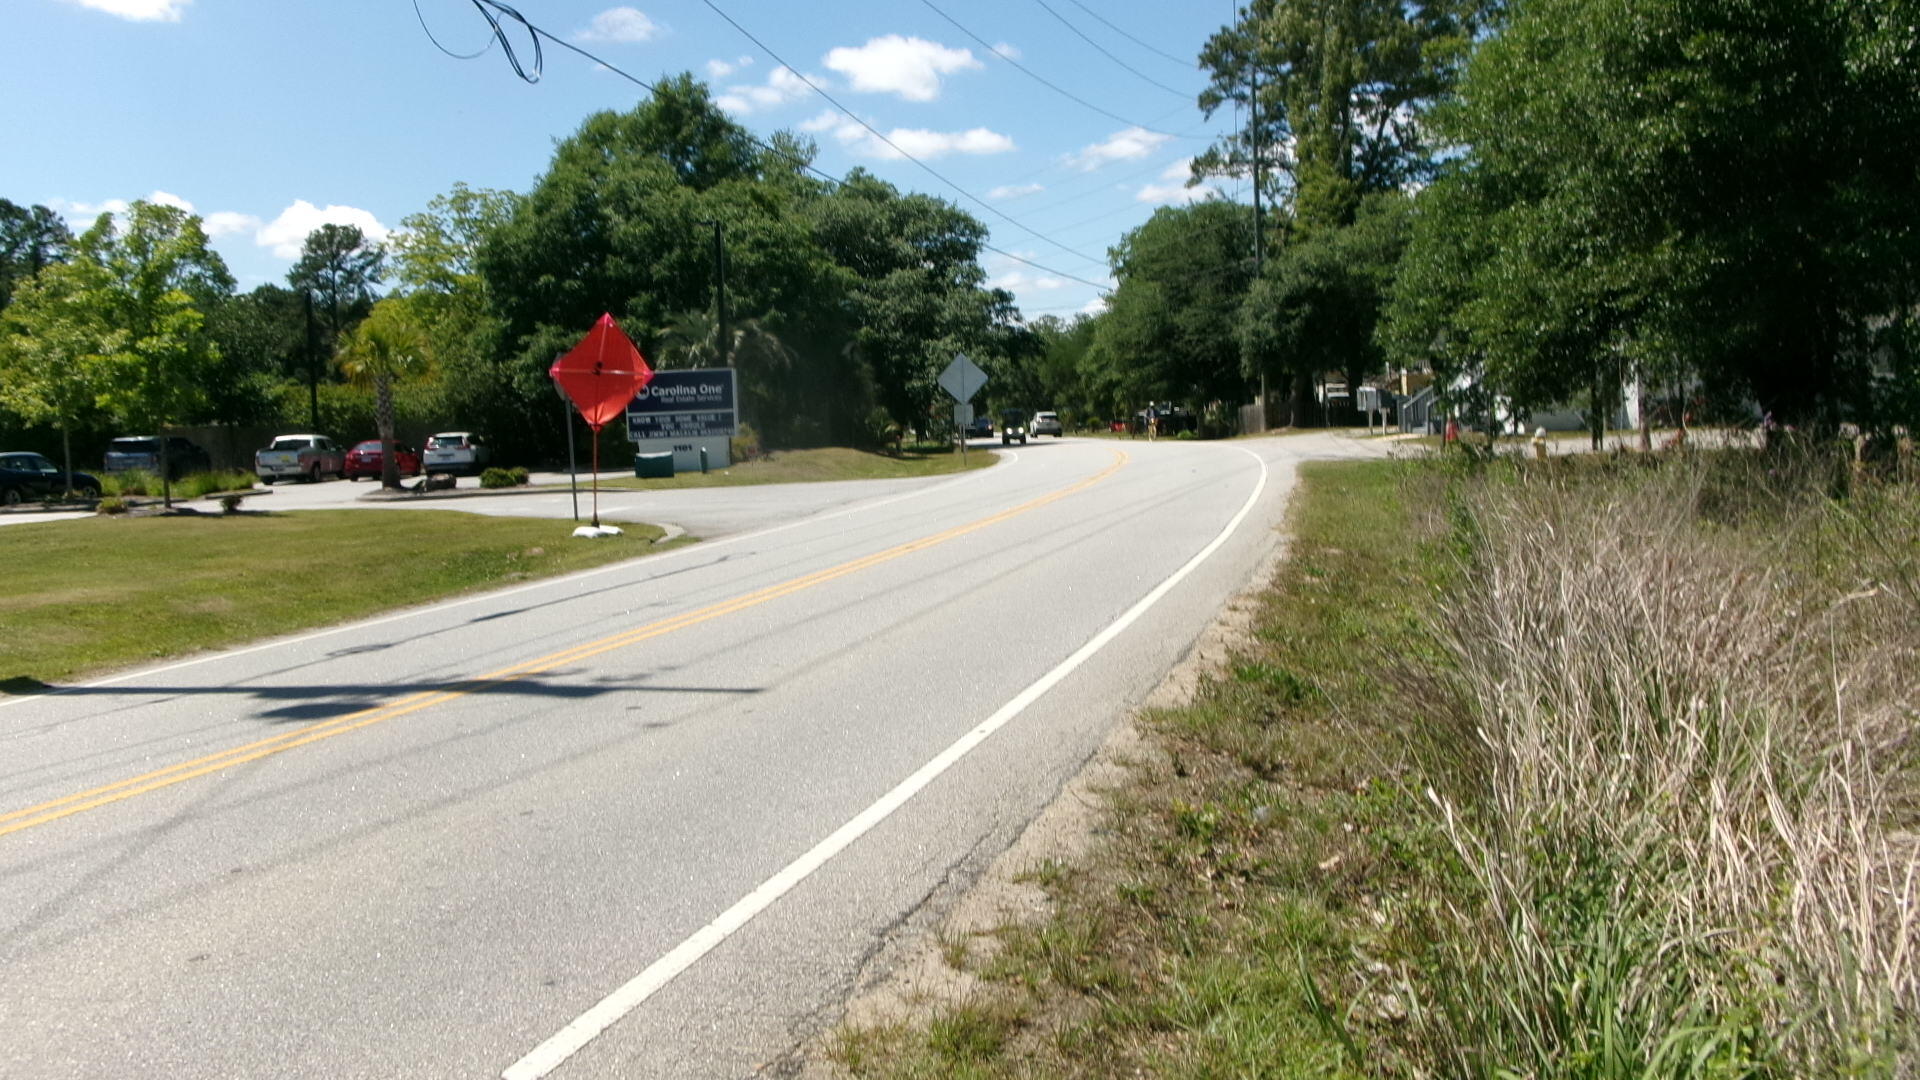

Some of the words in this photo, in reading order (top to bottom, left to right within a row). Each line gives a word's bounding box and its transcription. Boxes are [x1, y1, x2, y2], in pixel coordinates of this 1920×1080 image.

[651, 384, 697, 397] Carolina
[699, 383, 722, 394] One
[632, 416, 651, 424] KNOW
[673, 444, 693, 452] 1101
